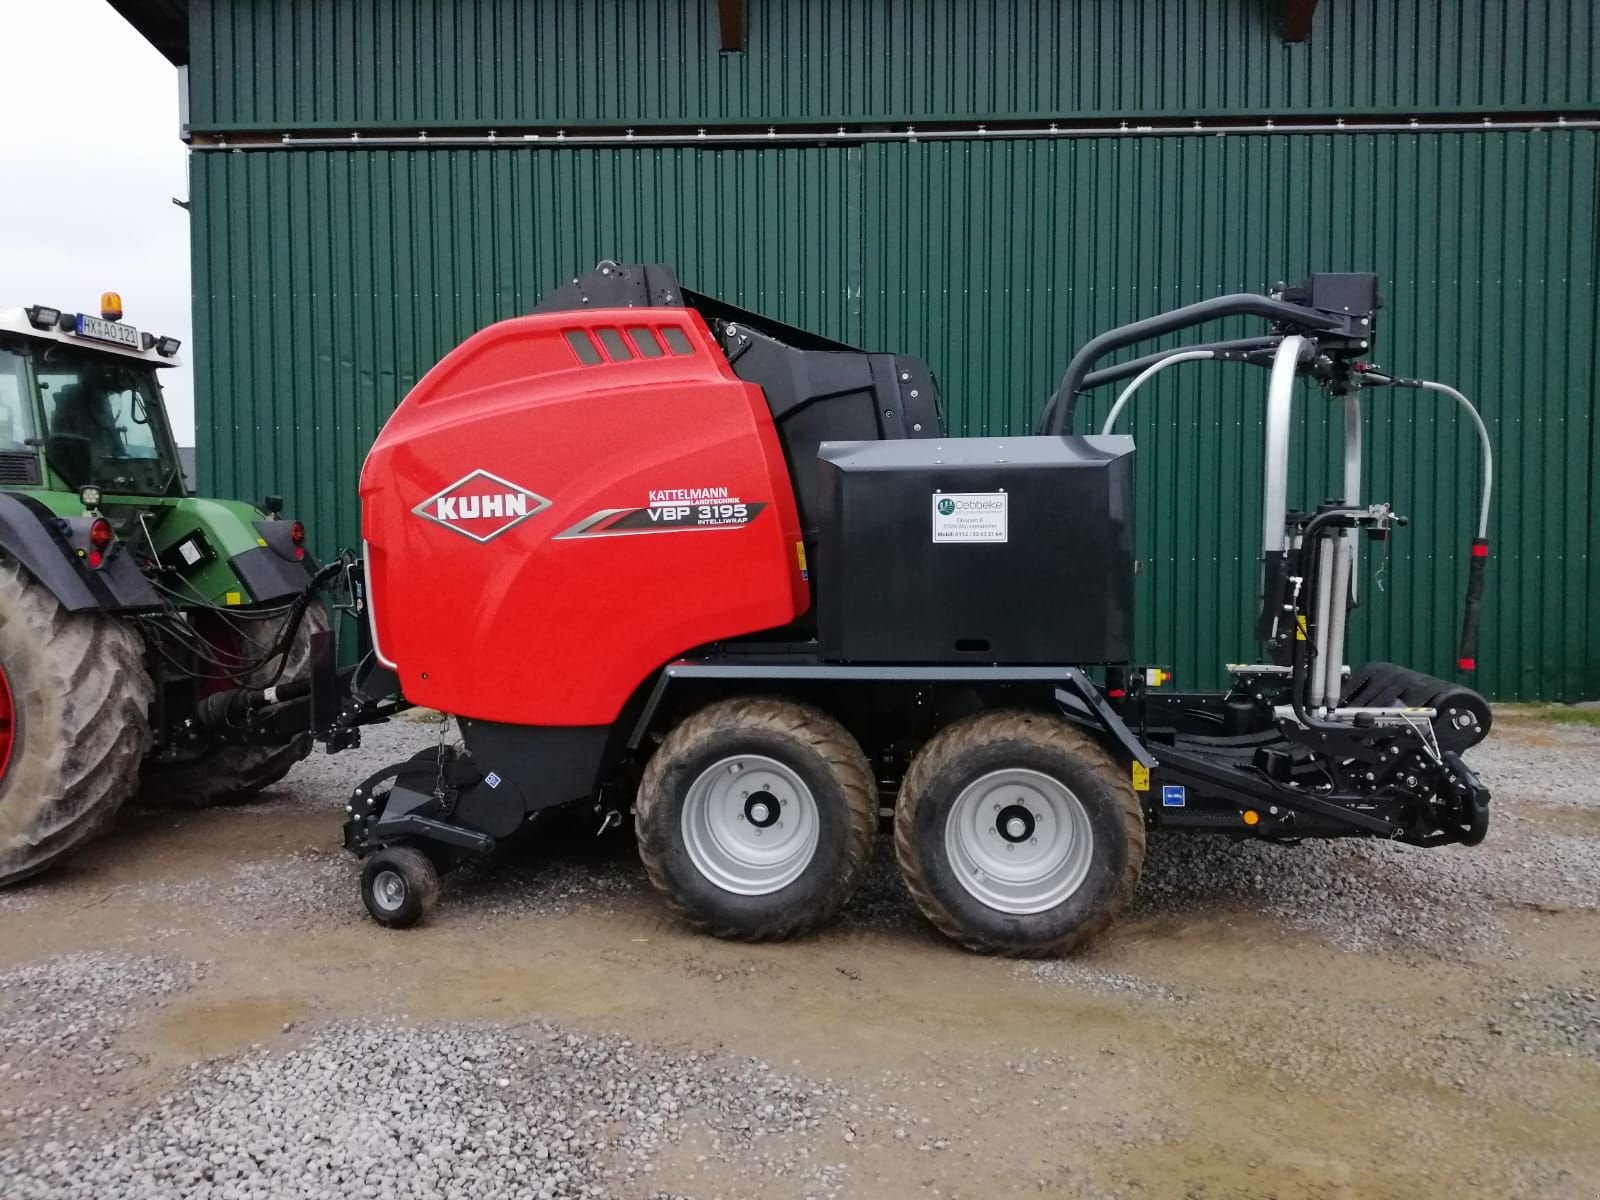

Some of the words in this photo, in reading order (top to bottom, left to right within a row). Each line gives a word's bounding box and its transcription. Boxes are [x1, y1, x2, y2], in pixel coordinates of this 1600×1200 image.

[84, 319, 96, 334] HX
[118, 326, 136, 344] 121
[649, 487, 728, 501] KATTELMANN
[690, 497, 740, 505] LANDTECHNIK
[437, 493, 527, 520] KUHN
[646, 506, 690, 522] VBP
[698, 504, 748, 519] 3195
[697, 517, 748, 525] INTELLIWRAP
